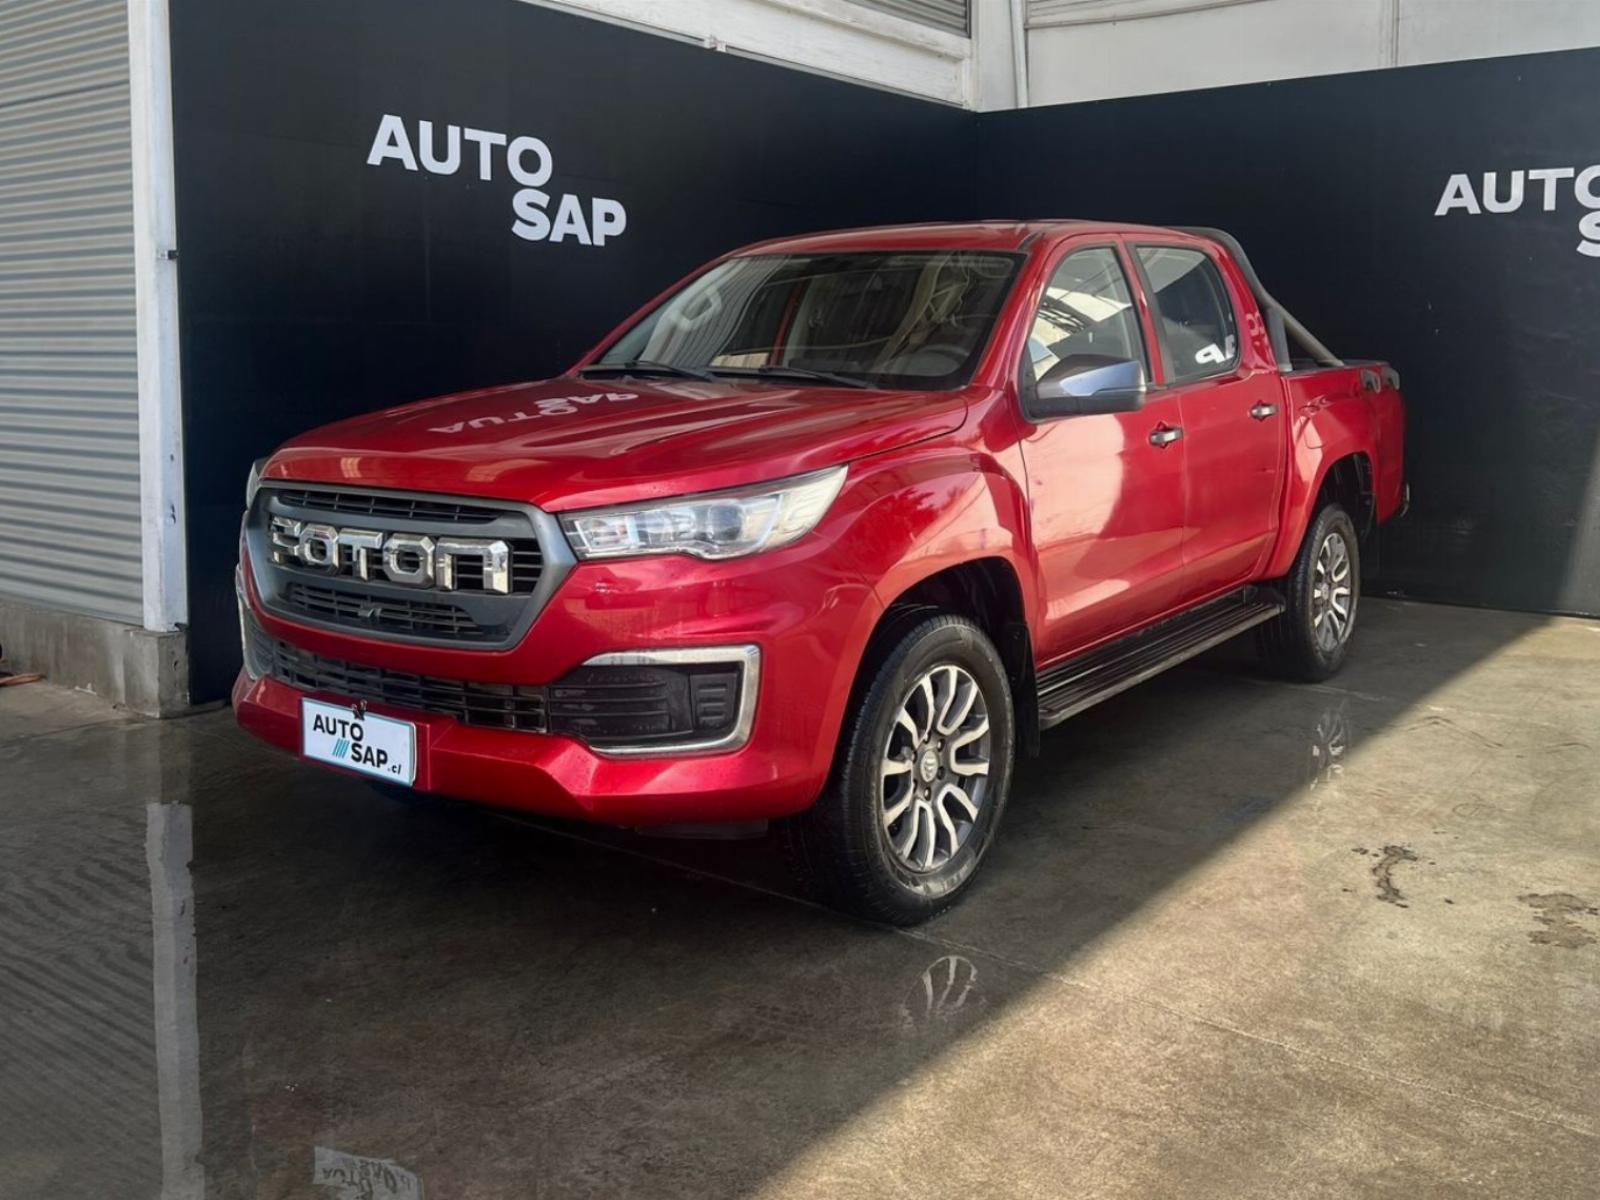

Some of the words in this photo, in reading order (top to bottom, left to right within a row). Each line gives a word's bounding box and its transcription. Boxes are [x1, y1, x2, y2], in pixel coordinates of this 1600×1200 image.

[366, 113, 553, 187] AUTO
[511, 188, 627, 247] SAP
[313, 713, 364, 742] AUTO
